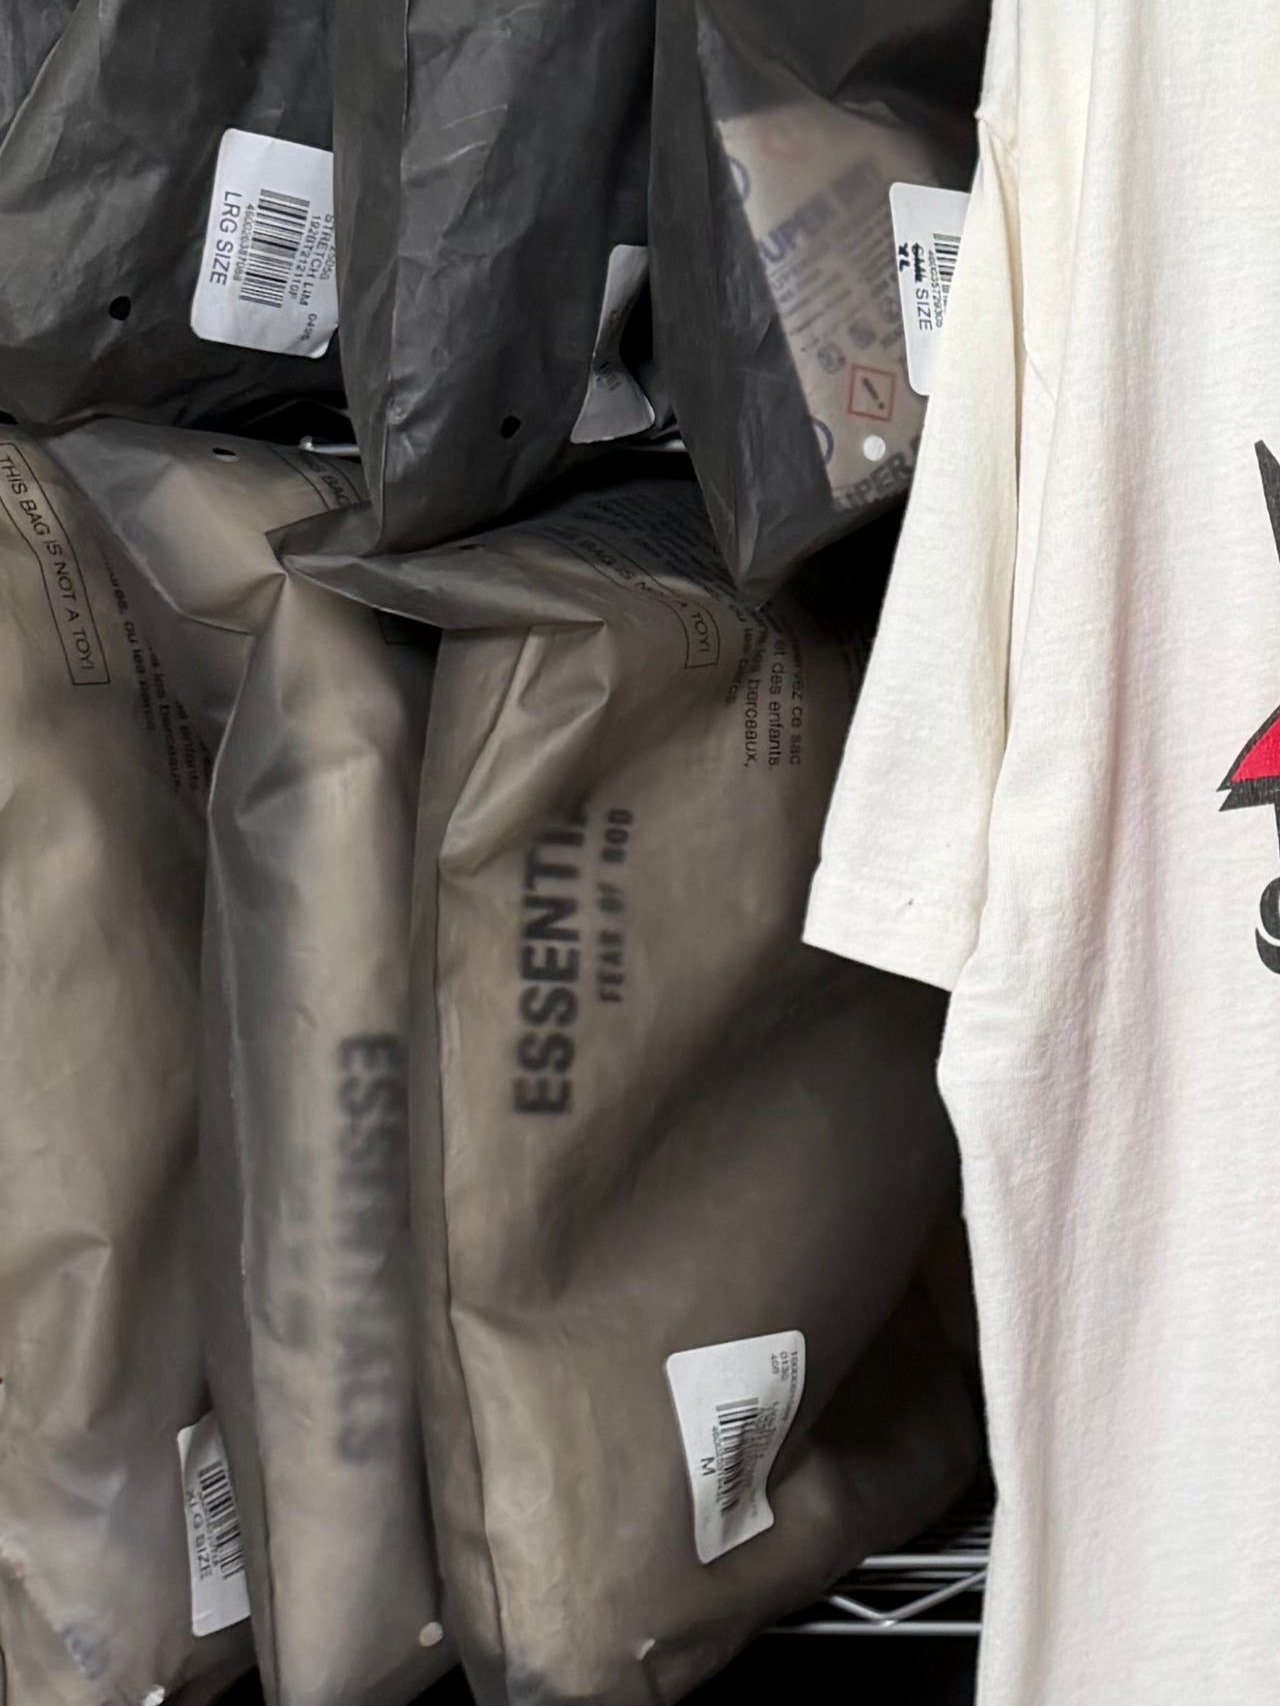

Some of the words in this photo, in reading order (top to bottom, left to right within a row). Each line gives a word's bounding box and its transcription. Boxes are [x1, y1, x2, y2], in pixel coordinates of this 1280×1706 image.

[219, 191, 242, 232] LRG
[210, 240, 233, 285] SIZE
[915, 287, 933, 332] SIZE
[0, 453, 28, 496] THIS
[19, 499, 52, 538] BAG
[40, 538, 60, 557] IS
[53, 561, 78, 602] NOT
[65, 607, 81, 623] A
[123, 620, 139, 644] ou
[689, 611, 711, 655] TOY!
[72, 626, 97, 672] TOY!
[774, 639, 788, 656] et
[769, 662, 785, 695] des
[743, 679, 763, 769] berceaux,
[791, 707, 804, 729] ce
[789, 733, 803, 767] sac
[597, 929, 626, 1004] FEAR
[697, 1455, 719, 1478] M
[195, 1533, 213, 1580] SIZE
